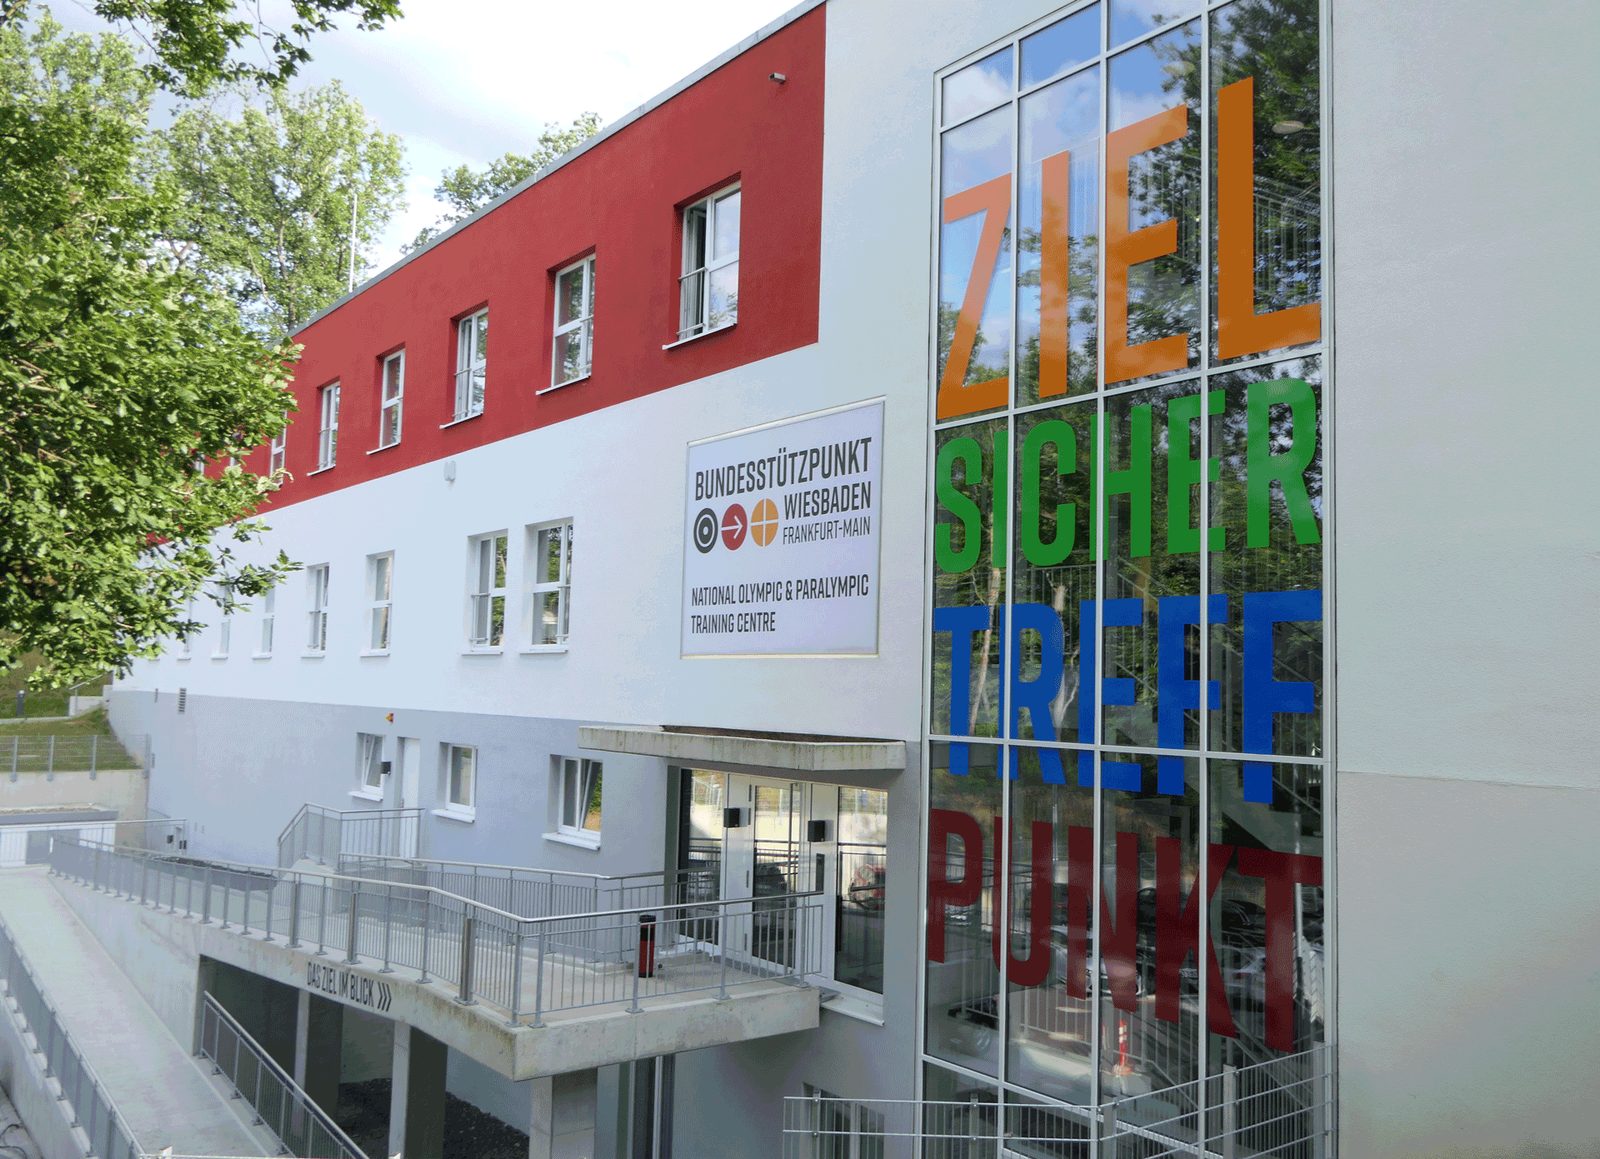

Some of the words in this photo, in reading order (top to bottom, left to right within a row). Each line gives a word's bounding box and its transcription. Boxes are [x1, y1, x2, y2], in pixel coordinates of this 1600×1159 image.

[937, 76, 1321, 420] ZIEL
[695, 437, 872, 501] BUNDESSTÜTZPUNKT
[934, 378, 1322, 574] SICHER
[784, 481, 871, 521] WIESBADEN
[782, 516, 871, 545] FRANKFURT-MAIN
[691, 584, 736, 607] NATIONAL
[738, 581, 783, 605] OLYMPIC
[785, 580, 793, 601] &
[796, 573, 869, 601] PARALYMPIC
[691, 612, 735, 635] TRAINING
[737, 611, 776, 634] CENTRE
[934, 590, 1322, 804] TREFF
[927, 808, 1322, 1053] PUNKT
[307, 961, 321, 989] DAS
[321, 966, 337, 995] ZIEL
[339, 971, 349, 998] IM
[350, 974, 374, 1008] BLICK
